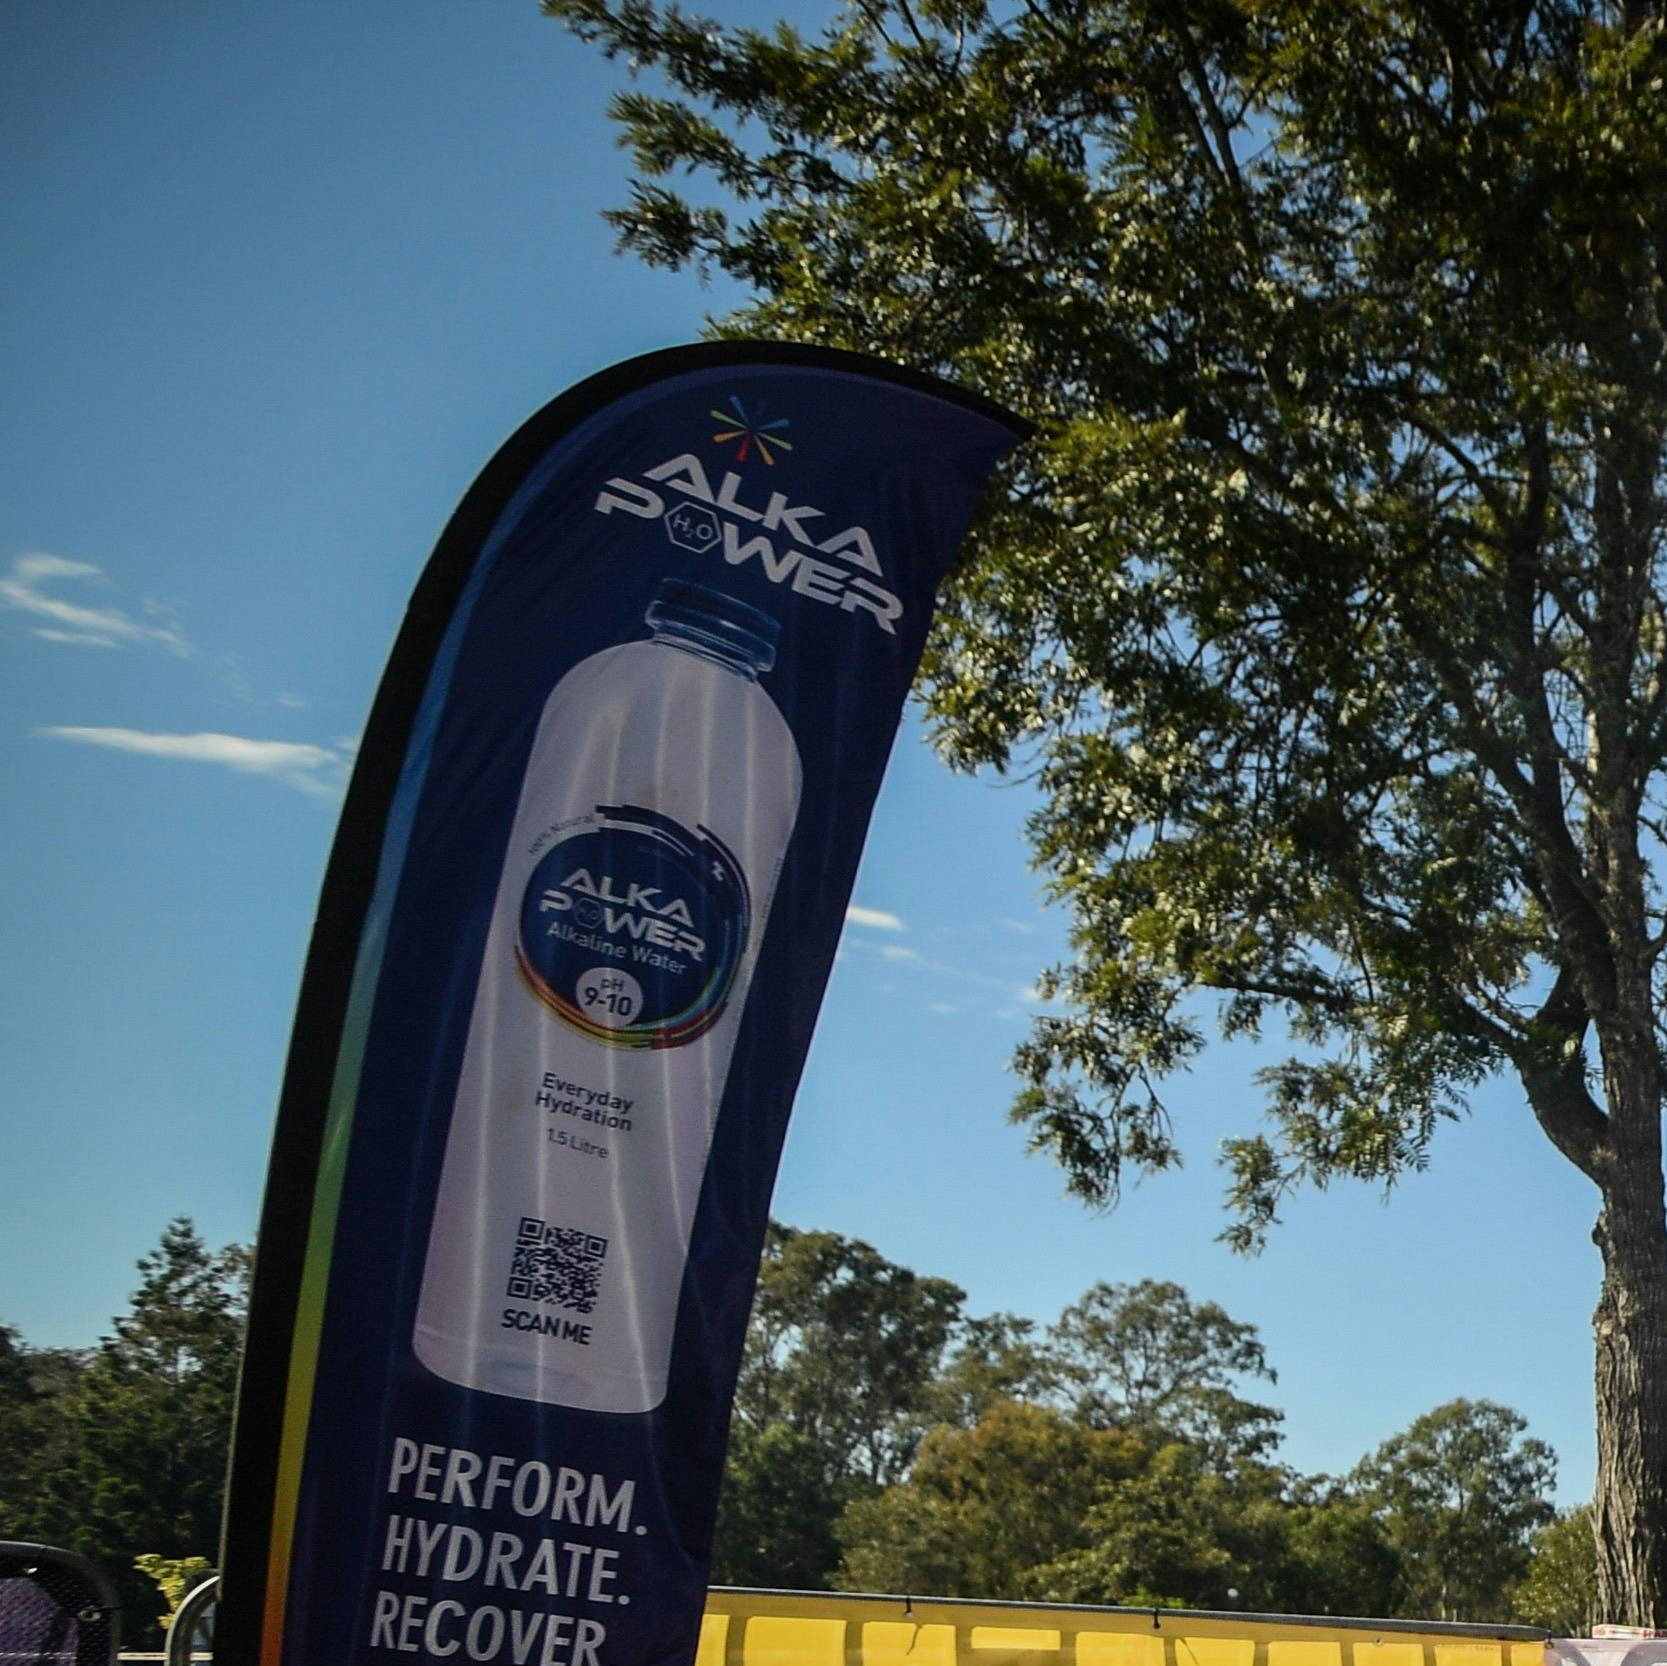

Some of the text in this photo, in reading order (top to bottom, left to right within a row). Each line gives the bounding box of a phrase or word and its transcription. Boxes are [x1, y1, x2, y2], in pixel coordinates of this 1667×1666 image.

[643, 454, 883, 577] ALKA
[560, 868, 694, 927] ALKA
[547, 920, 688, 975] Alkaline Water
[584, 987, 633, 1016] 9-10
[600, 976, 625, 992] pH
[535, 1091, 633, 1132] Hydration
[542, 1072, 634, 1113] Everyday
[570, 1136, 609, 1158] Litre
[501, 1308, 593, 1346] SCAN ME
[387, 1437, 647, 1536] PERFORM.
[381, 1514, 630, 1605] HYDRATE.
